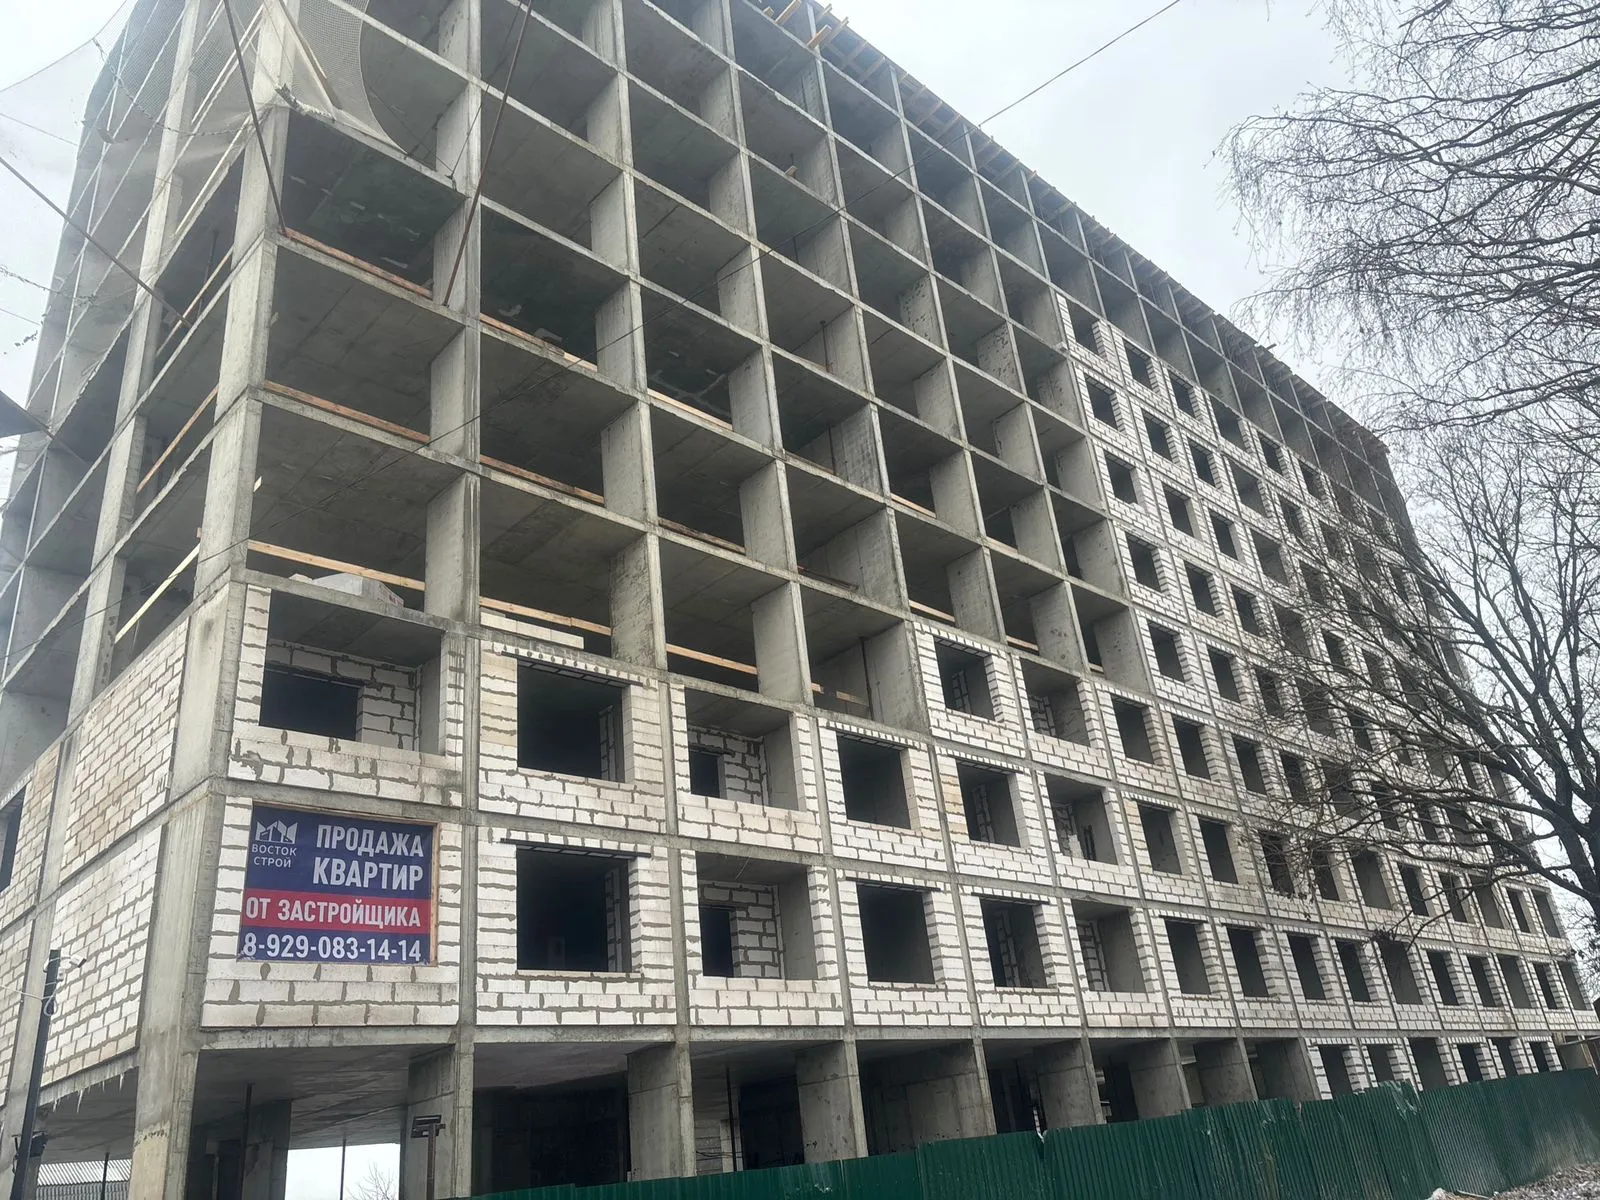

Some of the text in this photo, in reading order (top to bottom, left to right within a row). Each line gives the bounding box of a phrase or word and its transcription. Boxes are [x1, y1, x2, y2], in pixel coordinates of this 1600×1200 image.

[251, 843, 297, 857] ВОСТОК
[316, 824, 424, 858] ПРОДАЖА
[253, 856, 292, 868] СТРОЙ
[312, 856, 424, 891] КВАРТИР
[245, 896, 421, 929] ОТ ЗАСТРОЙЩИКА
[243, 932, 421, 962] 8-929-083-14-14
